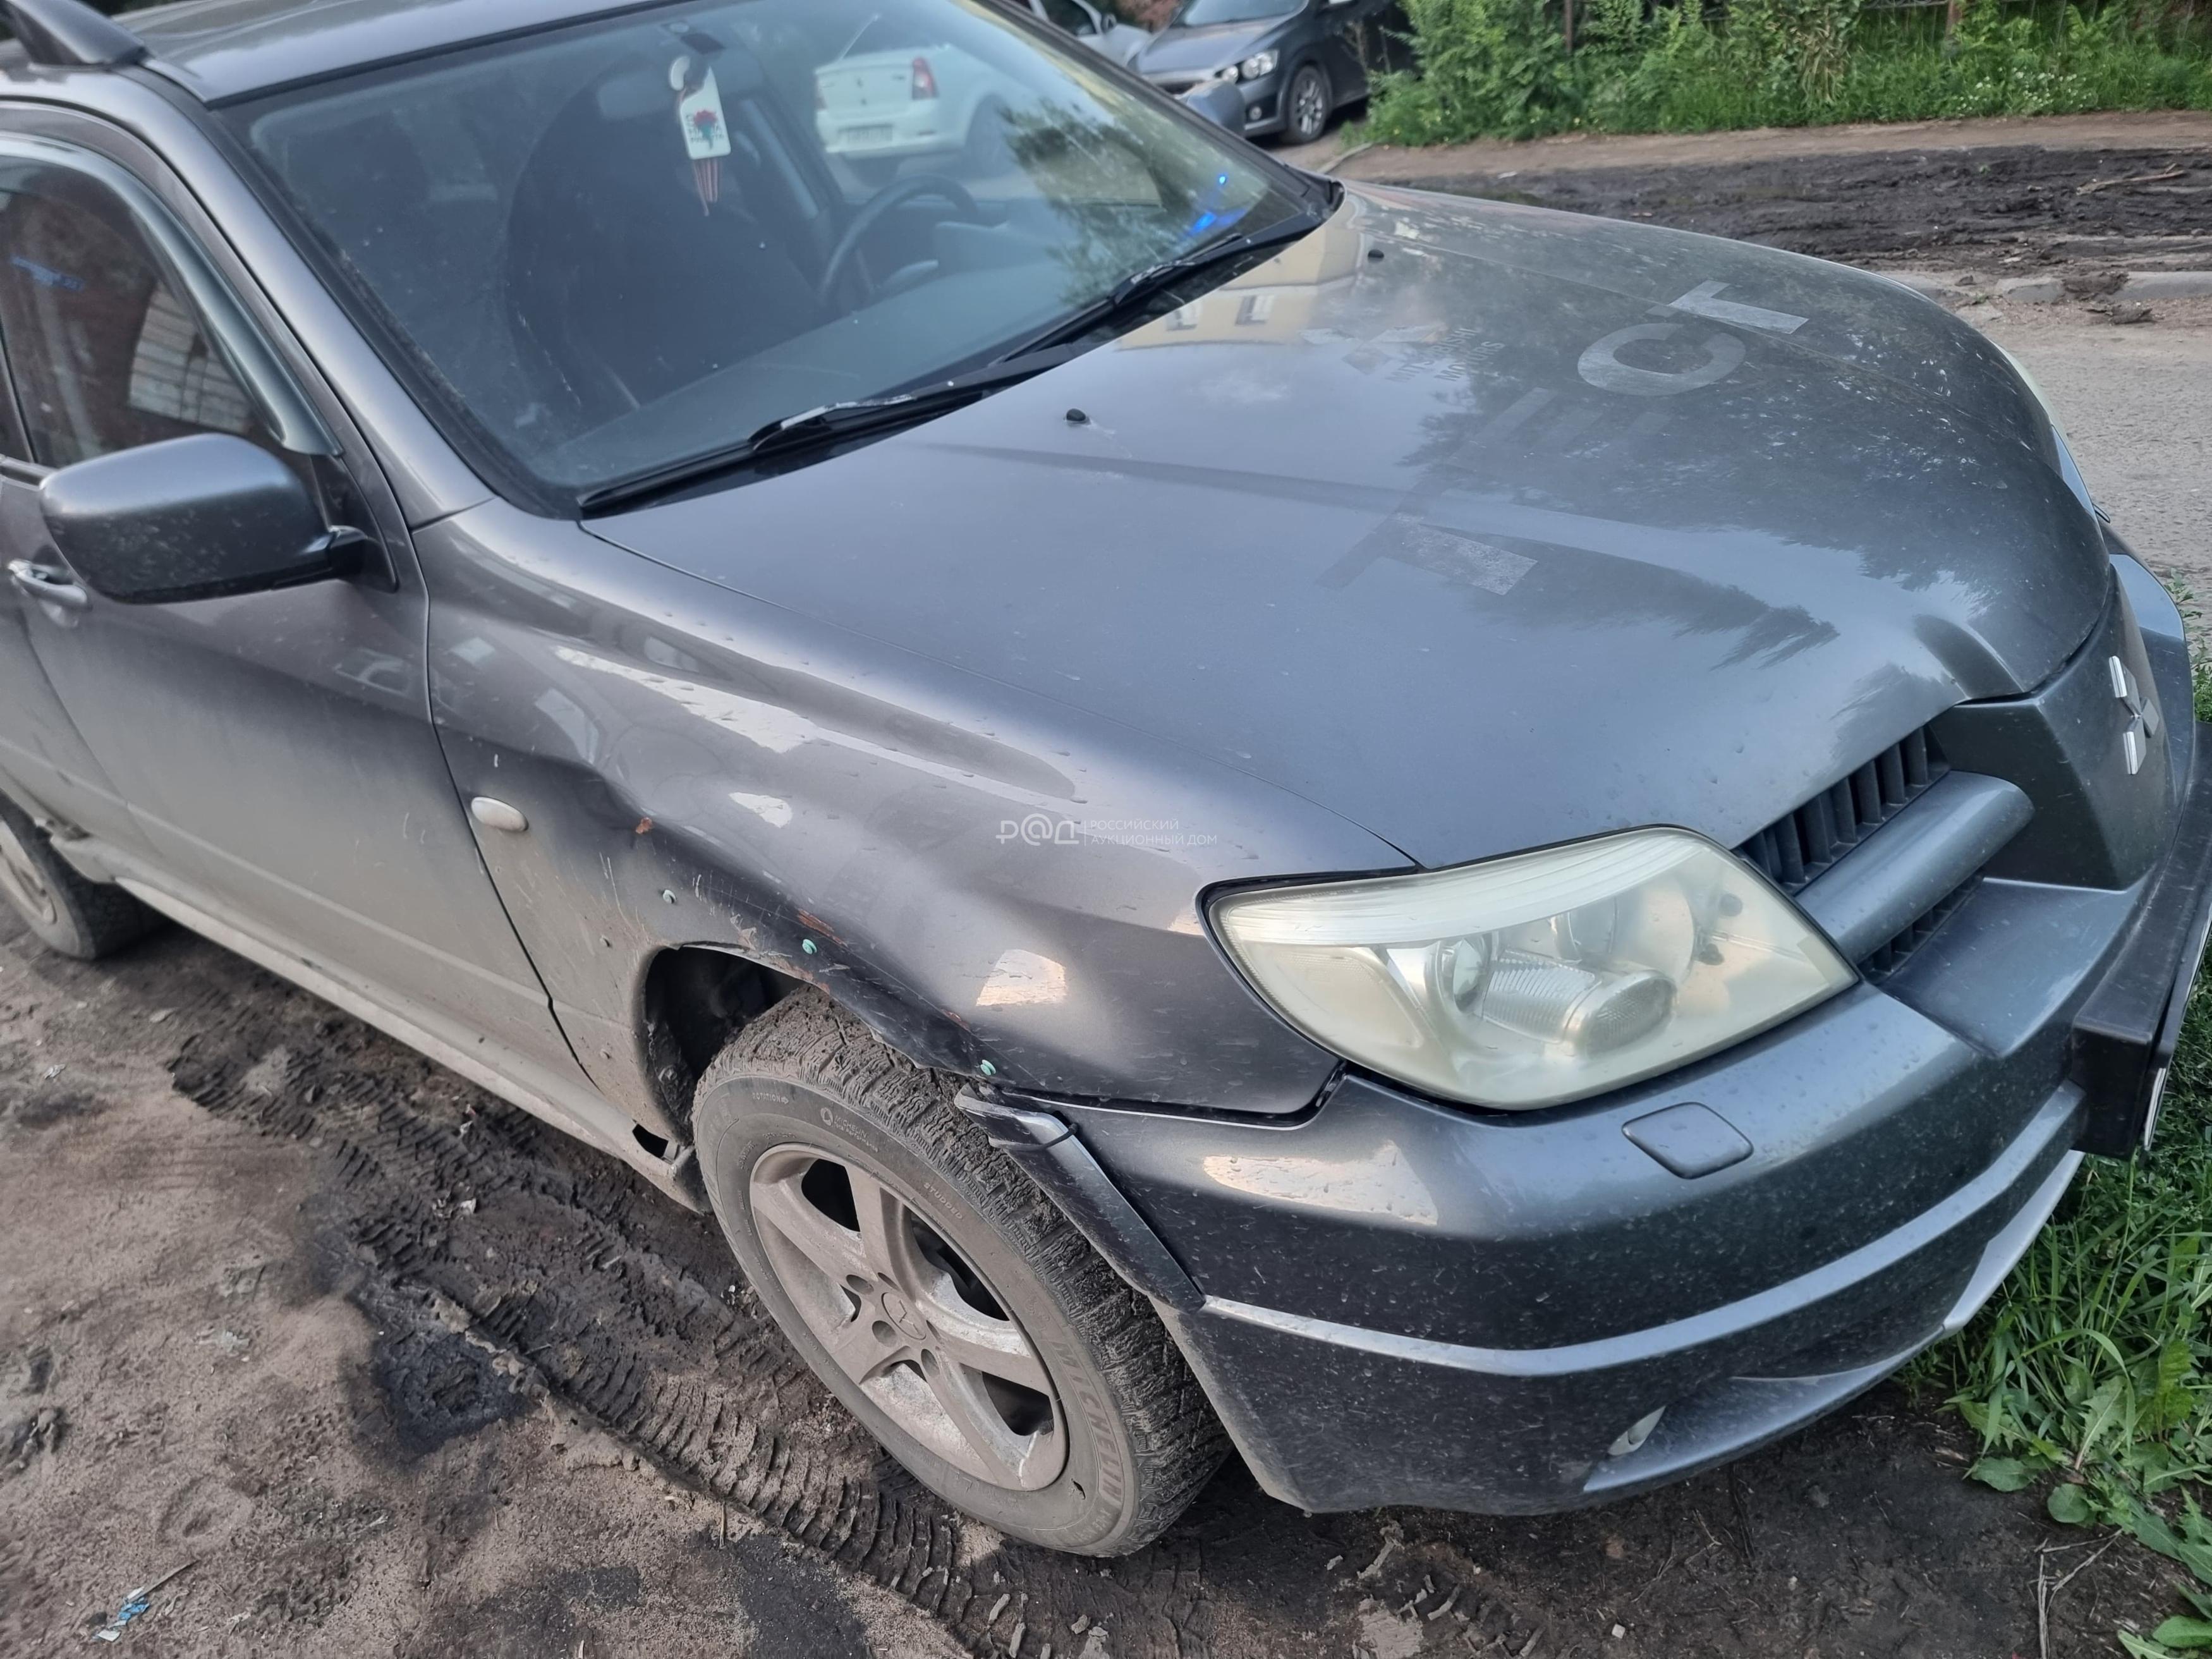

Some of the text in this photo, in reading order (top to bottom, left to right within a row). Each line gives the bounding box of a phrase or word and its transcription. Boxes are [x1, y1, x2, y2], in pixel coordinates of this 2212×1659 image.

[752, 1091, 781, 1103] ROTATION
[834, 1115, 868, 1139] MICHELIN
[923, 1182, 963, 1219] STUDDED
[1053, 1340, 1122, 1504] MICHELIN
